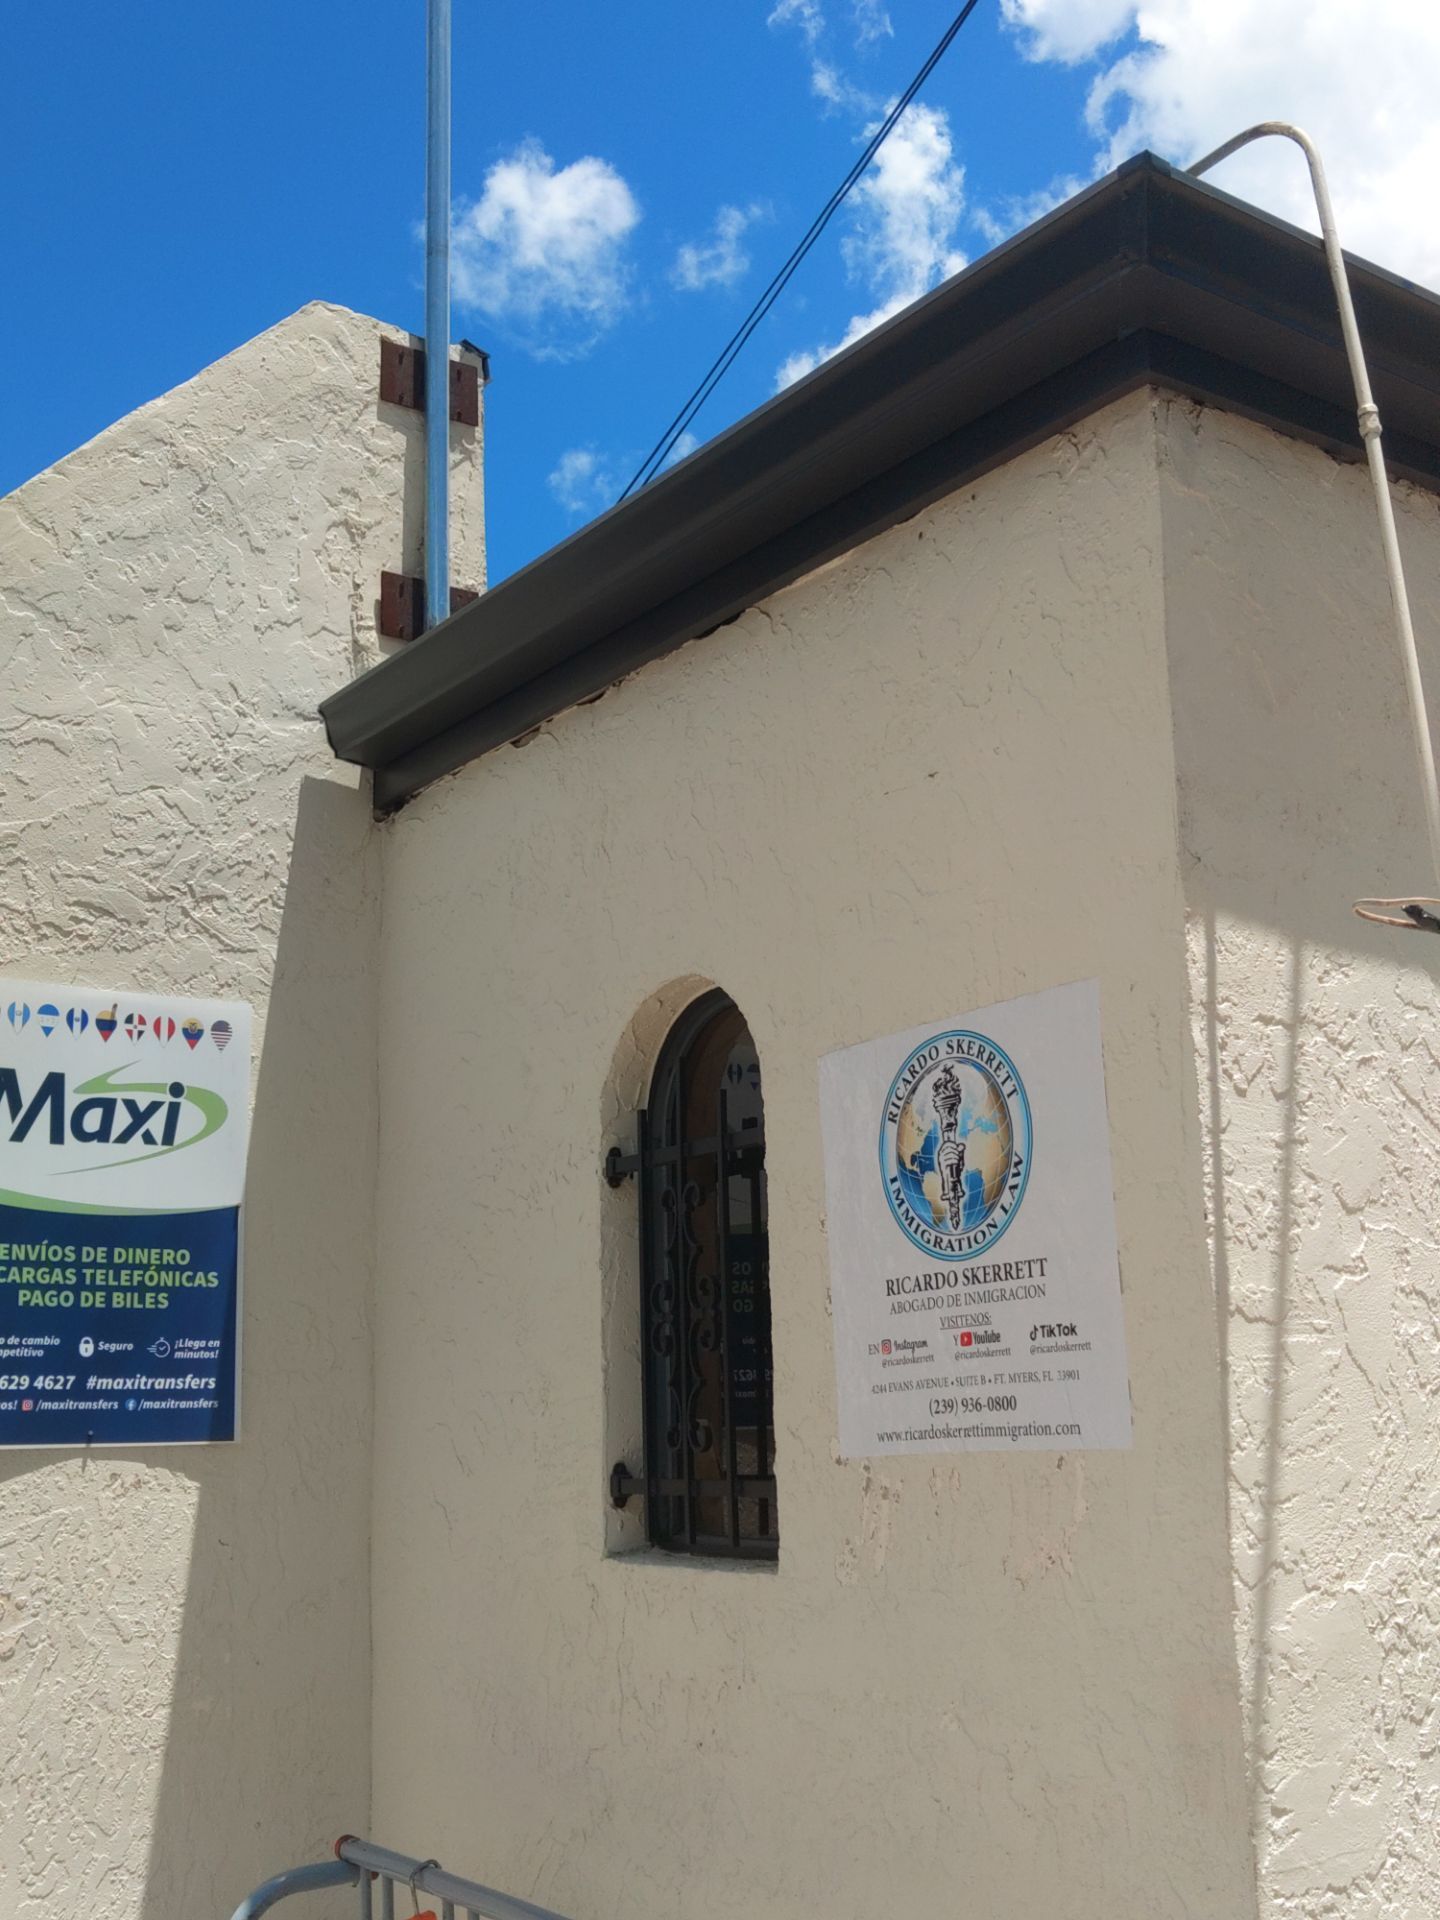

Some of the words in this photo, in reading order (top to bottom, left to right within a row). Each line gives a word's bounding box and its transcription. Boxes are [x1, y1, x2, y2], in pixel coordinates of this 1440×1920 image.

[888, 1045, 940, 1124] RICARDO
[946, 1038, 1019, 1099] SKERRETT
[0, 1067, 186, 1146] Maxi
[889, 1176, 999, 1252] IMMIGRATION
[1001, 1151, 1024, 1216] LAW
[0, 1240, 76, 1262] ENVÍOS
[81, 1246, 107, 1263] DE
[113, 1248, 191, 1265] DINERO
[82, 1266, 219, 1288] TELEFÓNICAS
[886, 1269, 958, 1297] RICARDO
[962, 1257, 1048, 1288] SKERRETT
[18, 1290, 74, 1307] PAGO
[80, 1291, 106, 1308] DE
[112, 1292, 169, 1309] BILES
[889, 1294, 944, 1315] ABOGADO
[947, 1292, 962, 1307] DE
[964, 1283, 1046, 1306] INMIGRACION
[939, 1312, 992, 1330] VISITENOS:
[973, 1331, 1001, 1346] YouTube
[1039, 1322, 1078, 1339] TikTok
[7, 1335, 20, 1345] de
[22, 1335, 60, 1346] cambio
[98, 1340, 134, 1353] Seguro
[207, 1339, 220, 1348] en
[868, 1343, 880, 1355] EN
[893, 1339, 928, 1355] Instagram
[1029, 1340, 1092, 1355] @ricardoskerrett
[0, 1347, 44, 1359] petitivo
[174, 1349, 219, 1359] minutos!
[954, 1347, 1011, 1361] @ricardoskerrett
[0, 1375, 29, 1390] 629
[33, 1375, 76, 1390] 4627
[86, 1373, 216, 1390] #maxitransfers
[888, 1380, 914, 1392] EVANS
[915, 1376, 949, 1390] AVENUE
[955, 1375, 979, 1387] SUITE
[980, 1374, 987, 1385] B
[1057, 1369, 1080, 1381] 33901
[36, 1398, 119, 1412] /maxitransfers
[138, 1398, 219, 1411] /maxitransfers
[929, 1397, 958, 1417] (239)
[961, 1395, 1017, 1413] 936-0800
[877, 1420, 1081, 1443] www.ricardoskerrettimmigration.com
